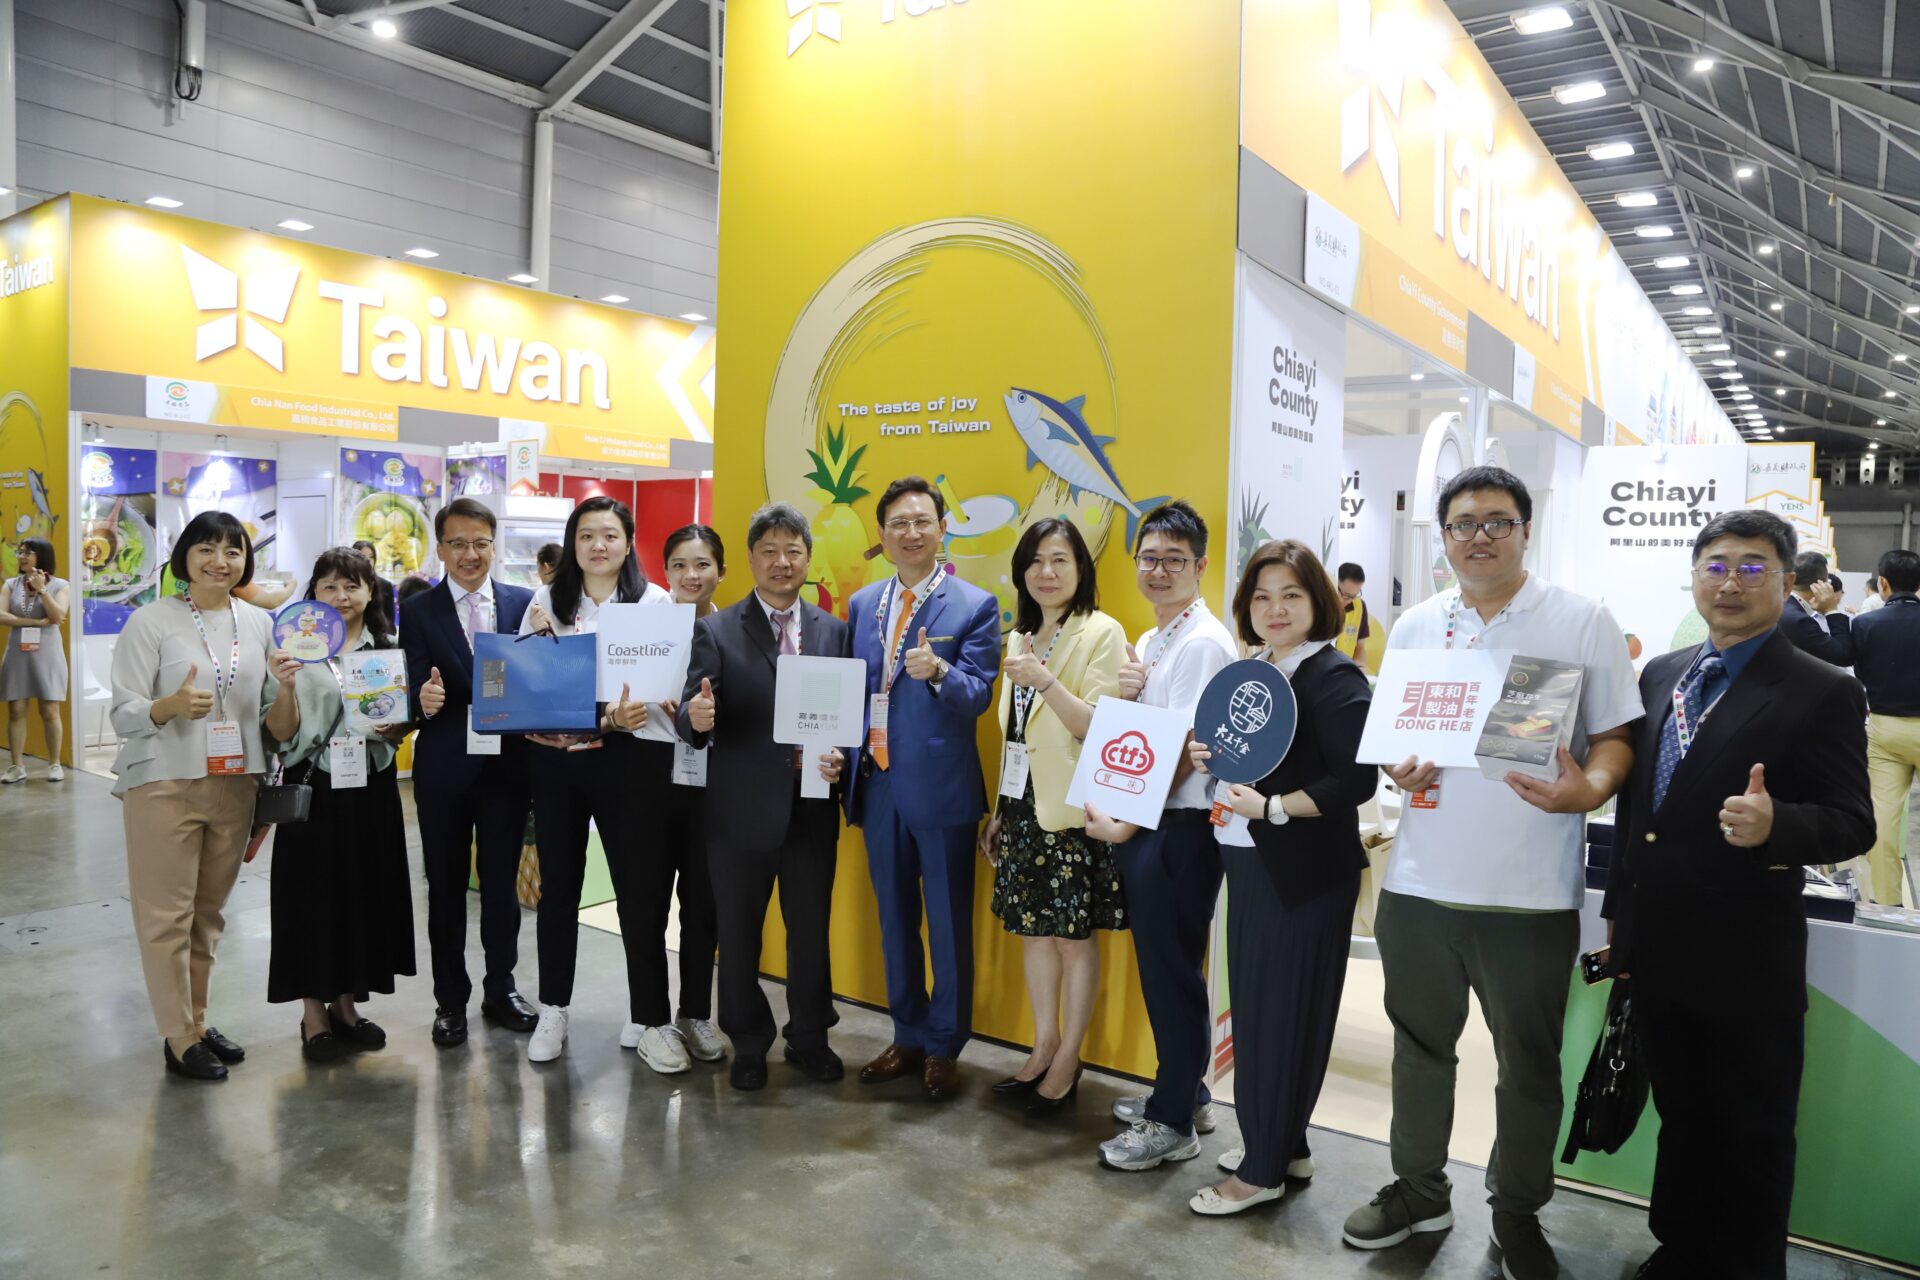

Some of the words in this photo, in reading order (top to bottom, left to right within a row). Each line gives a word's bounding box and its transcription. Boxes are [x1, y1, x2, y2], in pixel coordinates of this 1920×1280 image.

[1423, 62, 1561, 343] Taiwan
[0, 254, 54, 299] Taiwan
[318, 280, 611, 409] Taiwan
[1273, 345, 1317, 392] Chiayi
[250, 396, 272, 408] Chia
[274, 399, 294, 410] Nan
[295, 401, 318, 413] Food
[319, 403, 361, 417] Industrial
[838, 402, 869, 417] The
[873, 399, 921, 415] taste
[927, 396, 946, 411] of
[950, 395, 978, 413] joy
[1268, 377, 1318, 426] County
[879, 422, 922, 437] from
[927, 419, 991, 434] Taiwan
[1610, 479, 1717, 508] Chiayi
[607, 643, 670, 657] Coastline
[1429, 684, 1462, 699] 東和
[1424, 702, 1458, 716] 製油
[1459, 682, 1480, 732] 百年老店
[1395, 719, 1436, 731] DONG
[1438, 720, 1459, 731] HE
